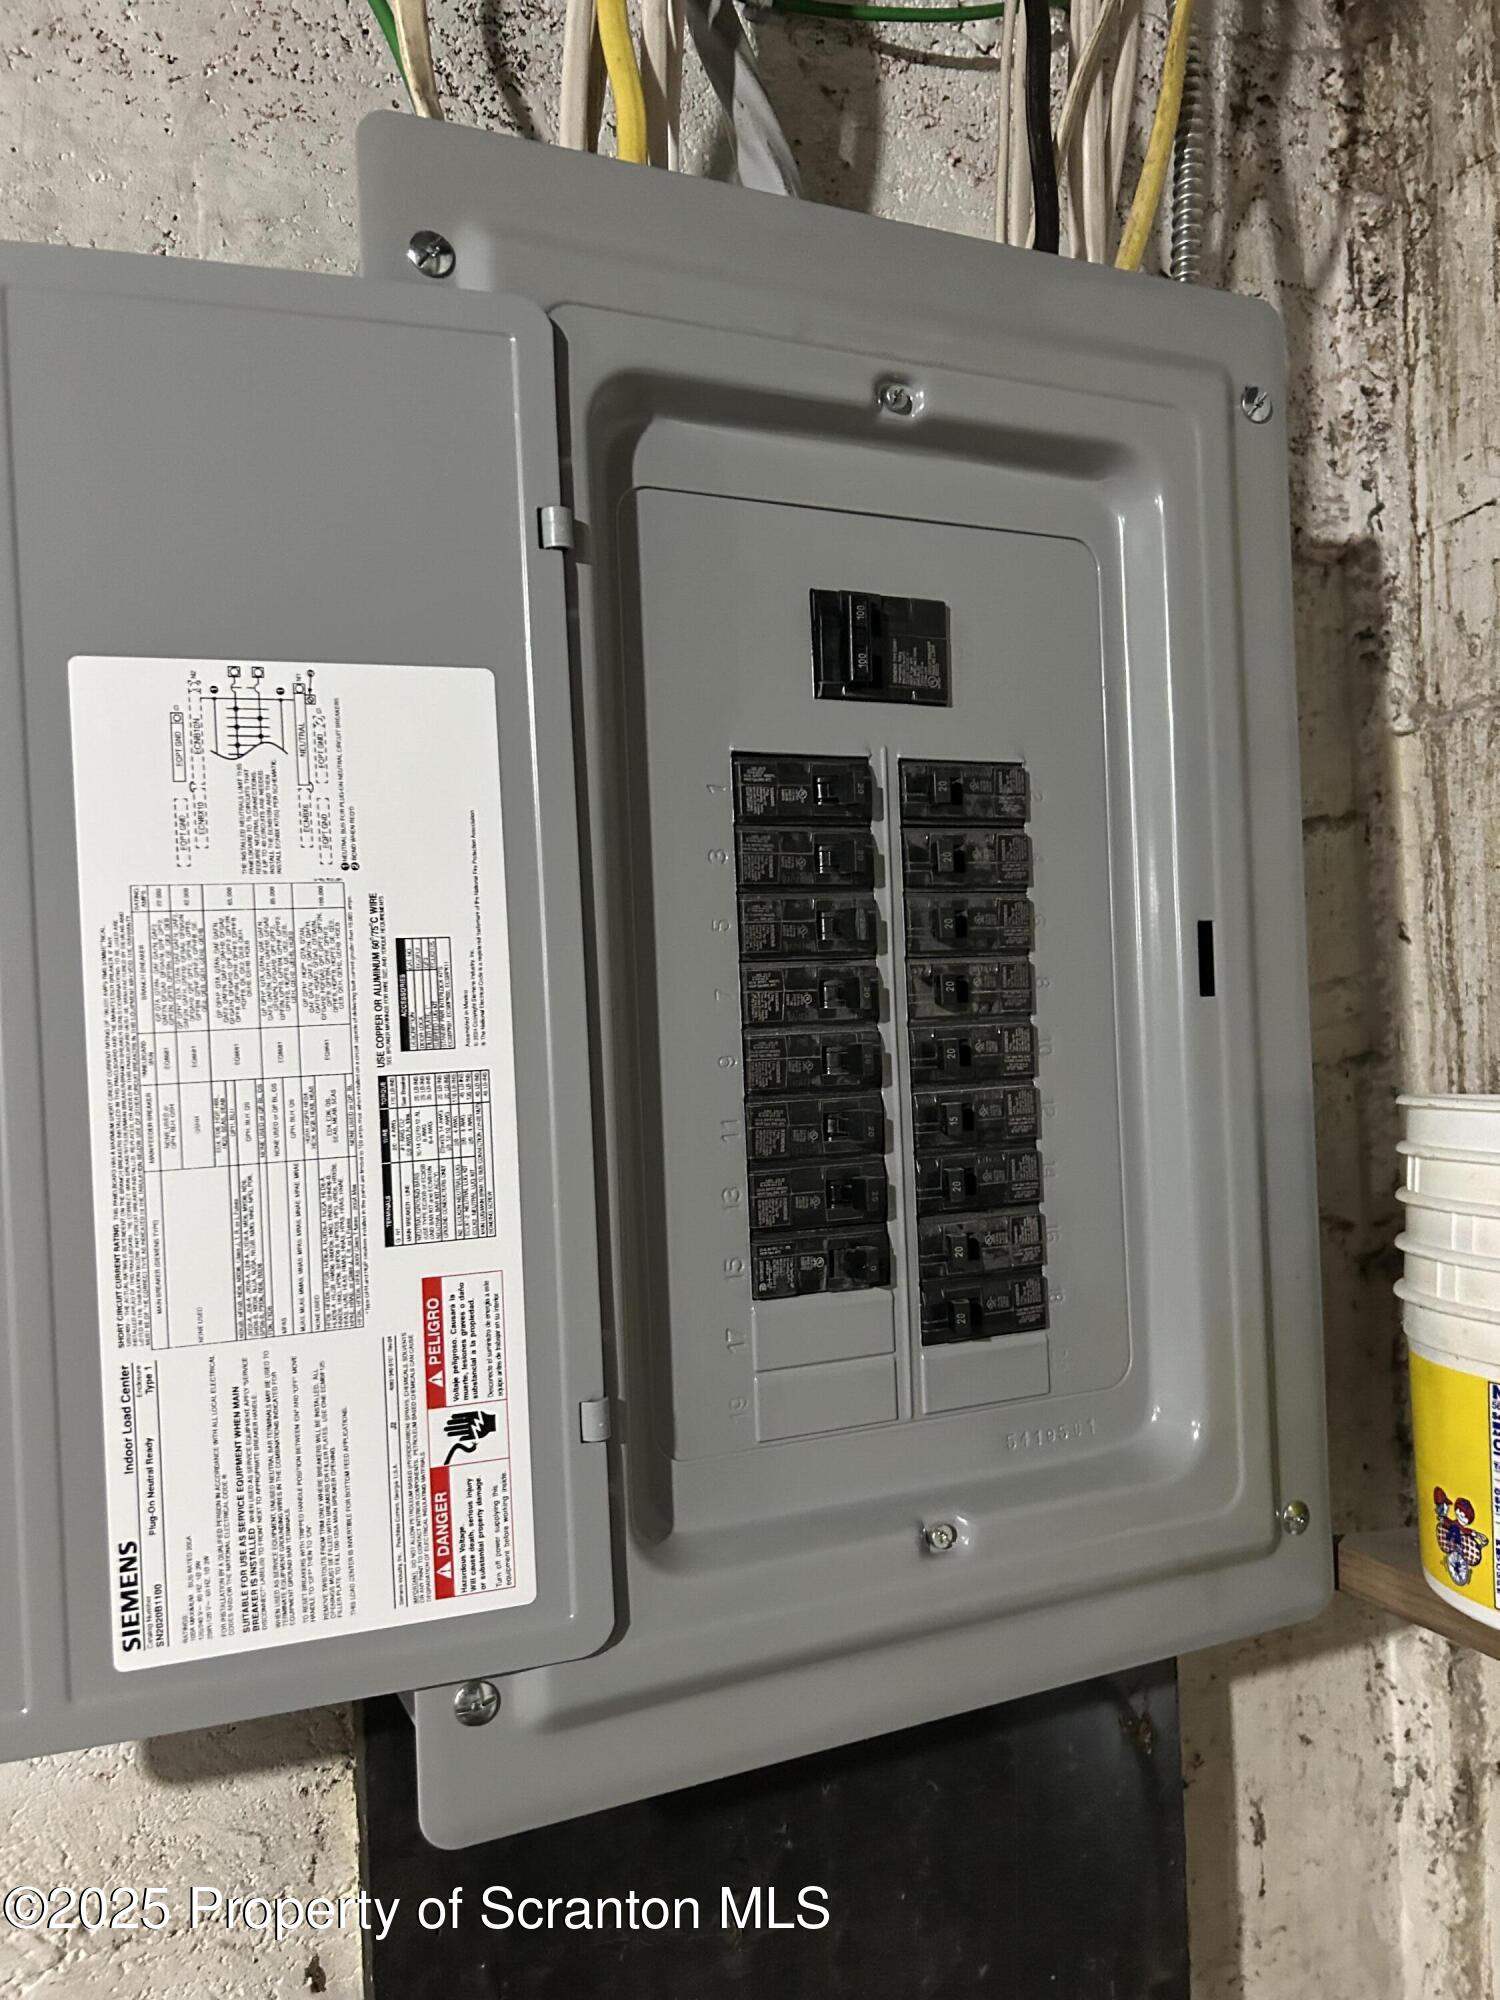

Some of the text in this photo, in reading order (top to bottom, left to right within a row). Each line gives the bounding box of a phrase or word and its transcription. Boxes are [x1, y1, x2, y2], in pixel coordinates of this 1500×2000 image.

[856, 605, 865, 620] 100
[858, 653, 867, 668] 100
[174, 730, 184, 766] EQPT GND
[192, 717, 202, 754] ECNB10N
[296, 720, 308, 757] NEUTRAL
[316, 733, 326, 768] EQPT GND
[938, 781, 948, 792] 20
[178, 814, 188, 850] EQPT GND
[320, 812, 330, 849] EQPT GND
[707, 848, 730, 863] 3
[942, 851, 952, 863] 20
[711, 918, 731, 932] 5
[943, 918, 954, 929] 20
[368, 893, 385, 1067] USE COPPER OR ALUMINUM 60°/75°C WIRE
[713, 988, 735, 1001] 7
[944, 981, 955, 992] 20
[1036, 977, 1051, 988] 8
[399, 973, 407, 1017] ACCESSORIES
[946, 1048, 956, 1059] 20
[1040, 1036, 1055, 1056] 10
[717, 1056, 738, 1068] 9
[379, 1080, 389, 1105] TORQUE
[948, 1116, 959, 1126] 15
[1042, 1099, 1057, 1118] 12
[720, 1119, 740, 1141] 11
[1044, 1160, 1058, 1178] 14
[722, 1185, 742, 1209] 13
[952, 1181, 962, 1192] 20
[385, 1193, 394, 1228] TERMINALS
[1047, 1225, 1062, 1242] 16
[151, 1219, 163, 1314] MAIN BREAKER (SIEMENS TYPE)
[954, 1246, 964, 1258] 20
[723, 1256, 745, 1280] 15
[112, 1223, 125, 1348] SHORT CIRCUIT CURRENT RATING
[457, 1281, 465, 1300] daño
[1049, 1287, 1064, 1304] 18
[426, 1297, 441, 1365] PELIGRO
[449, 1303, 457, 1334] Causará
[460, 1311, 468, 1336] graves
[467, 1297, 477, 1337] propiedad.
[956, 1313, 966, 1324] 20
[460, 1338, 468, 1369] lesiones
[468, 1339, 477, 1347] la
[725, 1328, 745, 1352] 17
[451, 1337, 460, 1374] peligroso.
[134, 1364, 143, 1397] Enclosure
[144, 1373, 155, 1394] Type
[452, 1376, 460, 1401] Voltaje
[461, 1371, 470, 1400] muerte,
[470, 1357, 478, 1398] substancial
[119, 1364, 134, 1474] Indoor Load Center
[729, 1396, 748, 1419] 19
[144, 1437, 158, 1535] Plug-On Neutral Ready
[475, 1474, 483, 1505] damage.
[231, 1386, 250, 1633] SUITABLE FOR USE AS SERVICE EQUIPMENT WHEN MAIN
[434, 1491, 450, 1556] DANGER
[476, 1508, 485, 1538] property
[465, 1477, 477, 1592] Will cause death, serious injury
[490, 1484, 503, 1587] Turn off power supplying this
[499, 1470, 512, 1585] equipment before working inside.
[458, 1523, 468, 1593] Hazardous Voltage.
[477, 1540, 486, 1579] substantial
[247, 1527, 260, 1631] BREAKER IS INSTALLED
[118, 1540, 141, 1652] SIEMENS
[143, 1595, 154, 1648] Catalog Number
[153, 1583, 164, 1647] SN2020B1100
